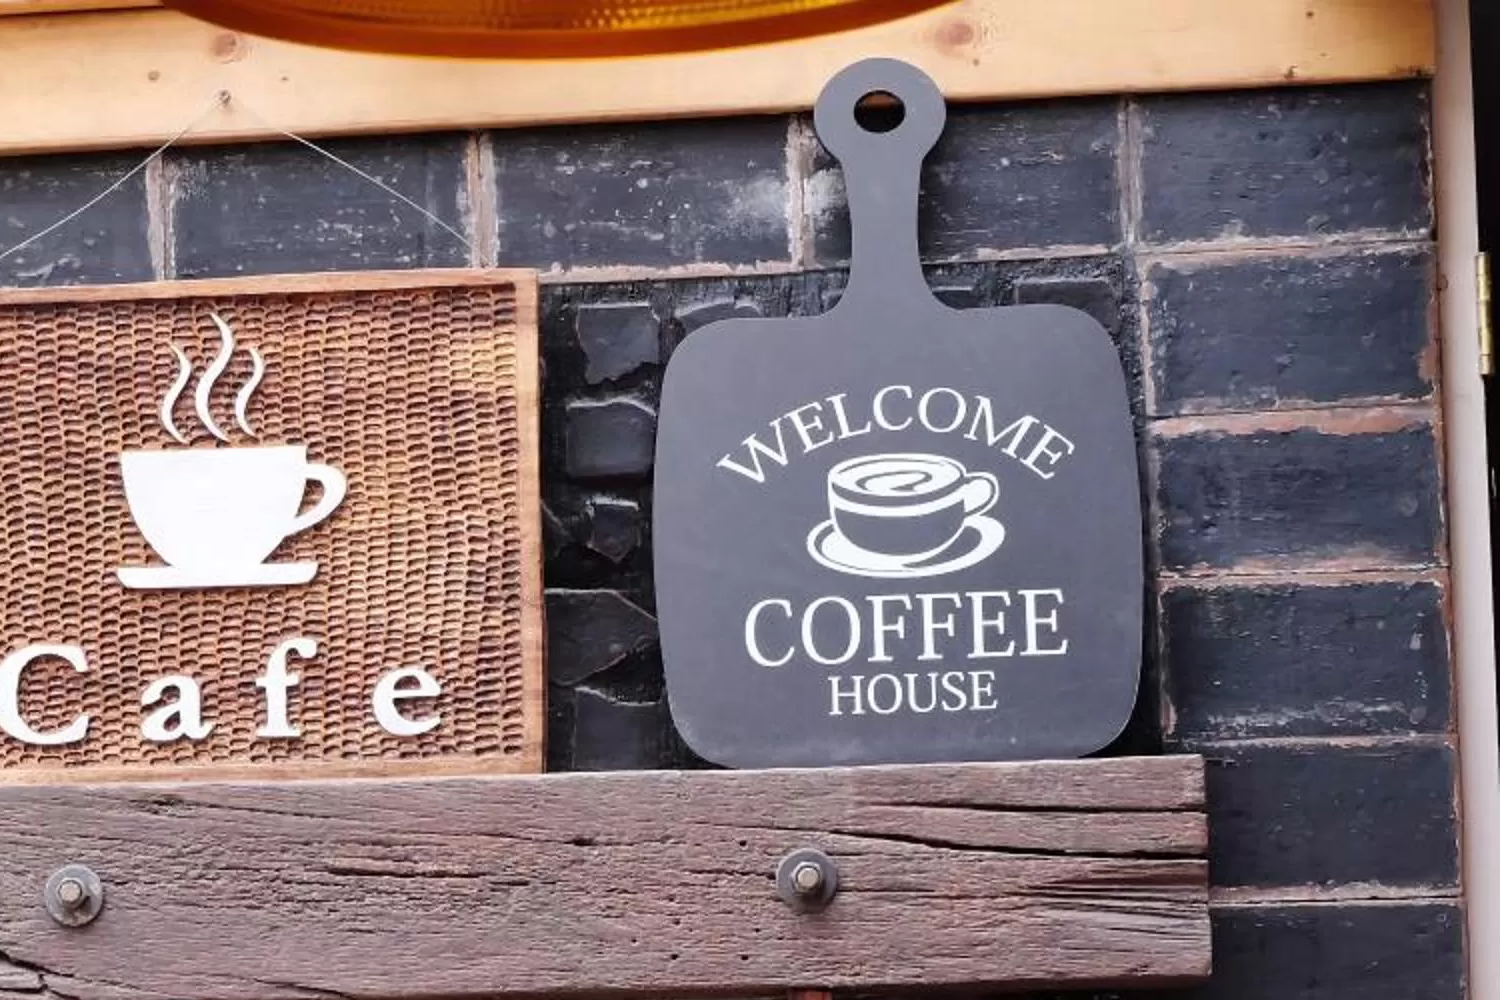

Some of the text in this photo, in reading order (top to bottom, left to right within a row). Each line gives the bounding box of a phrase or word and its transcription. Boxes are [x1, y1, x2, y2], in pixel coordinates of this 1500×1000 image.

[717, 385, 1075, 484] WELCOME
[744, 588, 1069, 667] COFFEE
[827, 671, 998, 715] HOUSE
